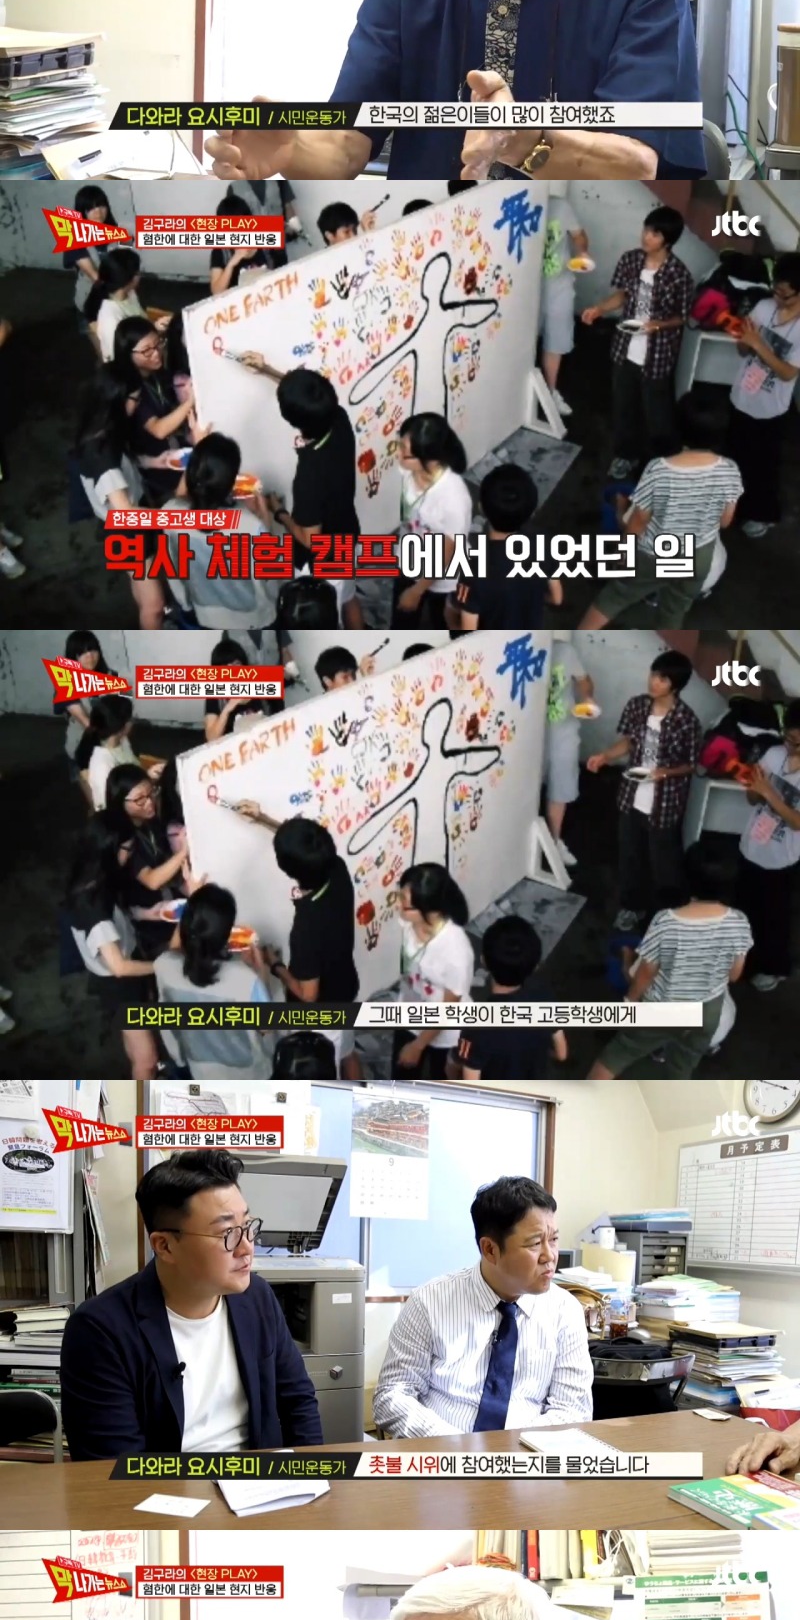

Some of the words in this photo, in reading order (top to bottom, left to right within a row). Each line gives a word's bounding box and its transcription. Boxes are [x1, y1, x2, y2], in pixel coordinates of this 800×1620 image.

[204, 305, 241, 335] ONE
[243, 270, 300, 319] EARTH
[198, 752, 235, 782] ONE
[238, 717, 295, 766] EARTH
[727, 1138, 780, 1155] 月予定表
